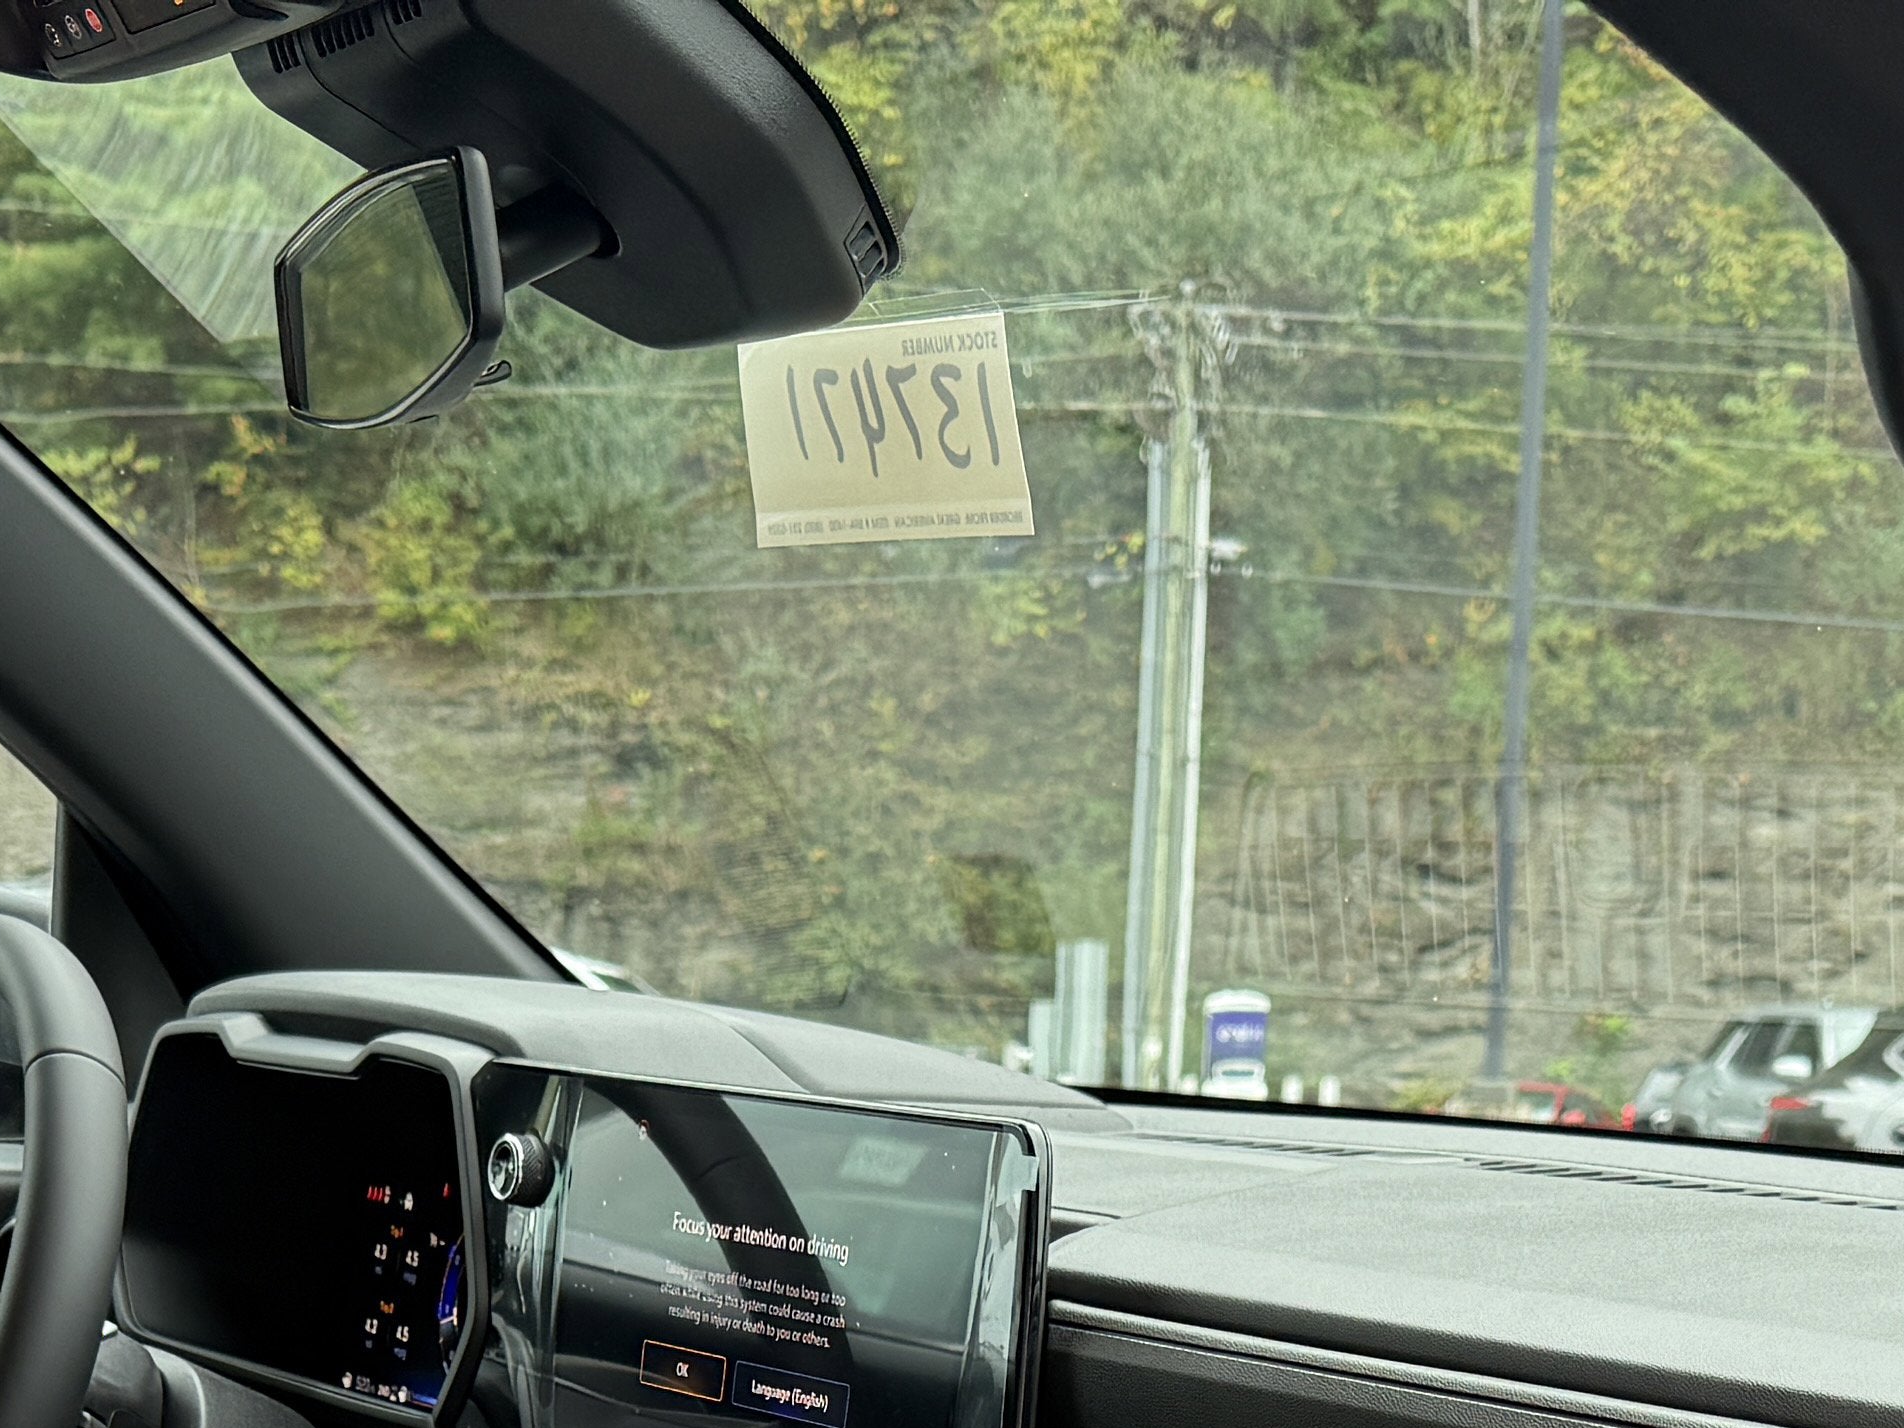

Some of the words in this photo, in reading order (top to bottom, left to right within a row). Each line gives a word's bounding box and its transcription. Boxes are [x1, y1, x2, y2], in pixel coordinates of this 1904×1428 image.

[672, 1211, 705, 1238] Focus
[705, 1222, 732, 1243] your
[733, 1224, 787, 1250] attention
[788, 1236, 805, 1253] on
[807, 1234, 850, 1267] driving
[739, 1274, 752, 1289] the
[753, 1277, 772, 1293] road
[772, 1279, 785, 1296] for
[785, 1284, 800, 1298] too
[800, 1284, 819, 1306] long
[831, 1293, 846, 1307] too
[668, 1304, 701, 1326] resulting
[701, 1310, 710, 1323] in
[710, 1311, 733, 1331] injury
[732, 1319, 742, 1331] or
[742, 1317, 766, 1336] death
[766, 1325, 775, 1336] to
[775, 1328, 791, 1342] you
[791, 1330, 801, 1342] or
[739, 1296, 767, 1314] system
[768, 1301, 791, 1317] could
[791, 1308, 815, 1323] cause
[822, 1313, 846, 1329] crash
[675, 1361, 689, 1379] OK
[751, 1379, 791, 1405] Language
[791, 1387, 829, 1414] (English)
